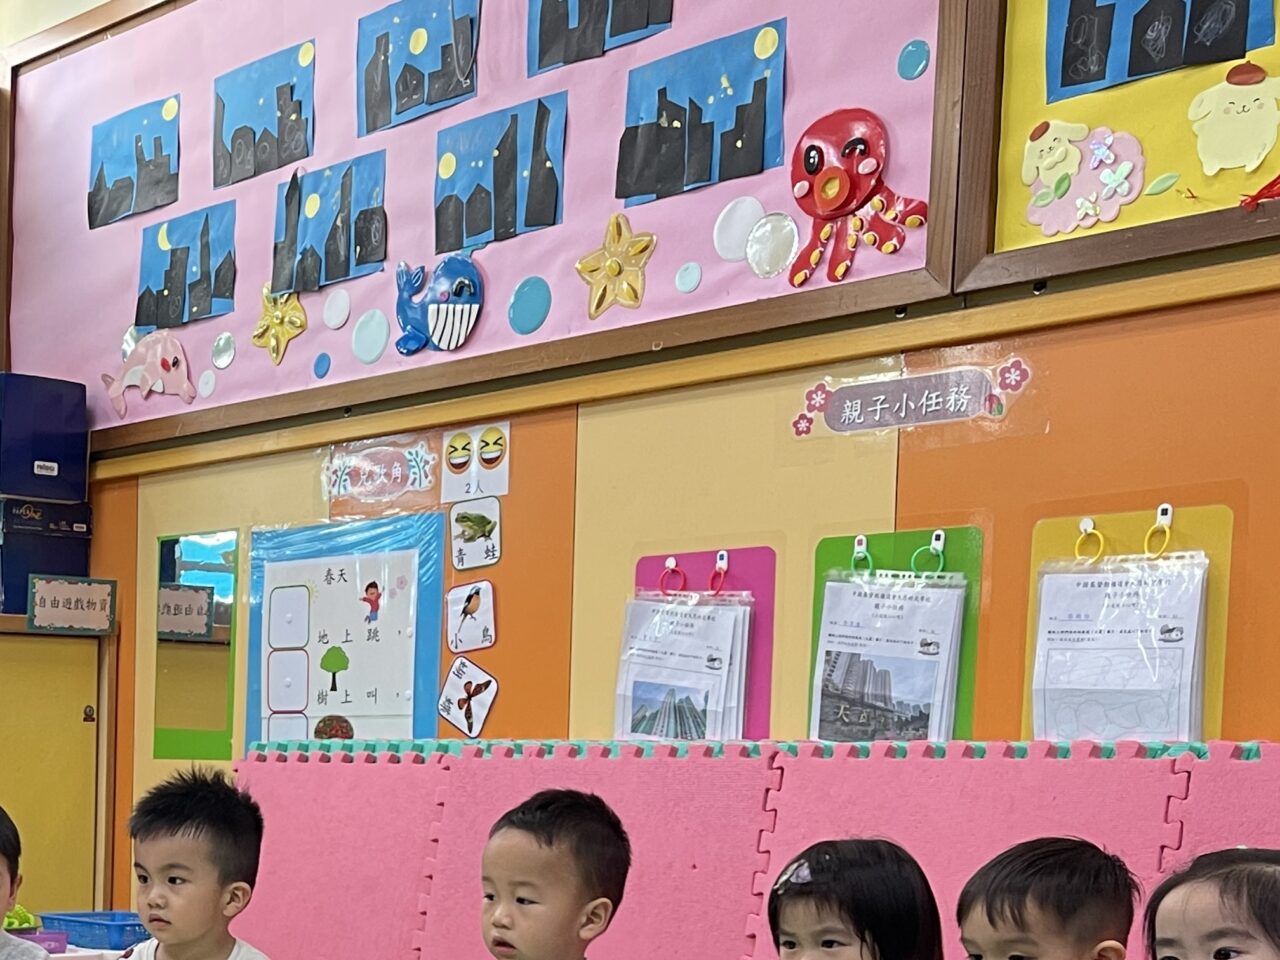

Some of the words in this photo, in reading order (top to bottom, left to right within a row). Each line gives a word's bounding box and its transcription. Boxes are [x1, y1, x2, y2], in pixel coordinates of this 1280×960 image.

[840, 384, 972, 425] 親子小任務
[464, 479, 484, 495] 2人
[455, 546, 498, 567] 青蛙
[323, 567, 348, 585] 春天
[450, 624, 493, 650] 小鳥
